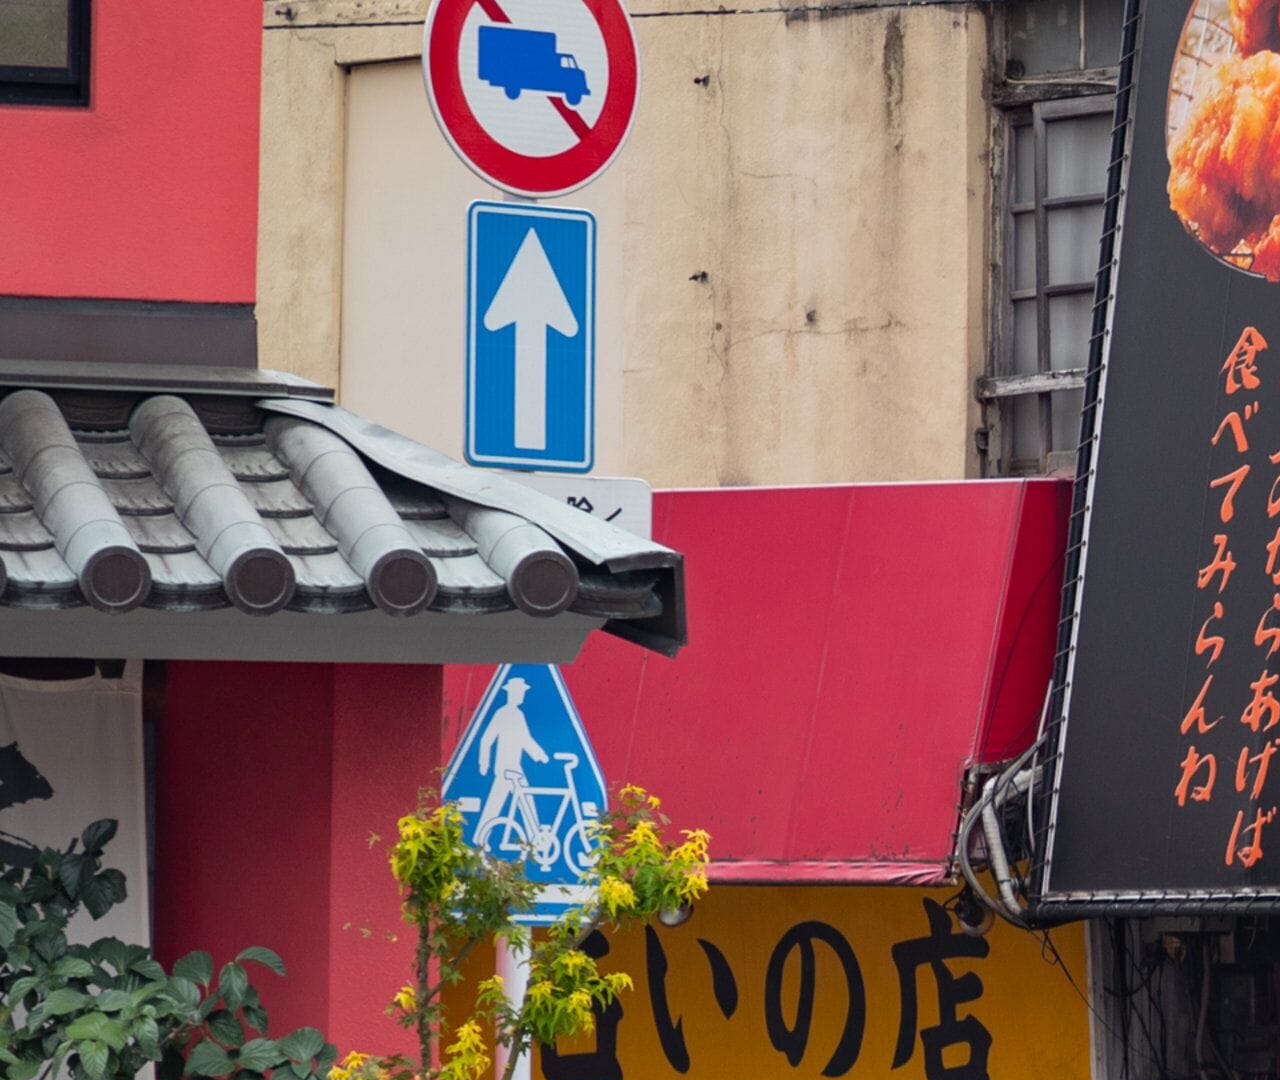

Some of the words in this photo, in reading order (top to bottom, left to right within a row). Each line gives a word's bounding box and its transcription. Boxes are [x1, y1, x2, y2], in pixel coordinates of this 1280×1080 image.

[1174, 326, 1270, 807] 食べてみらんね
